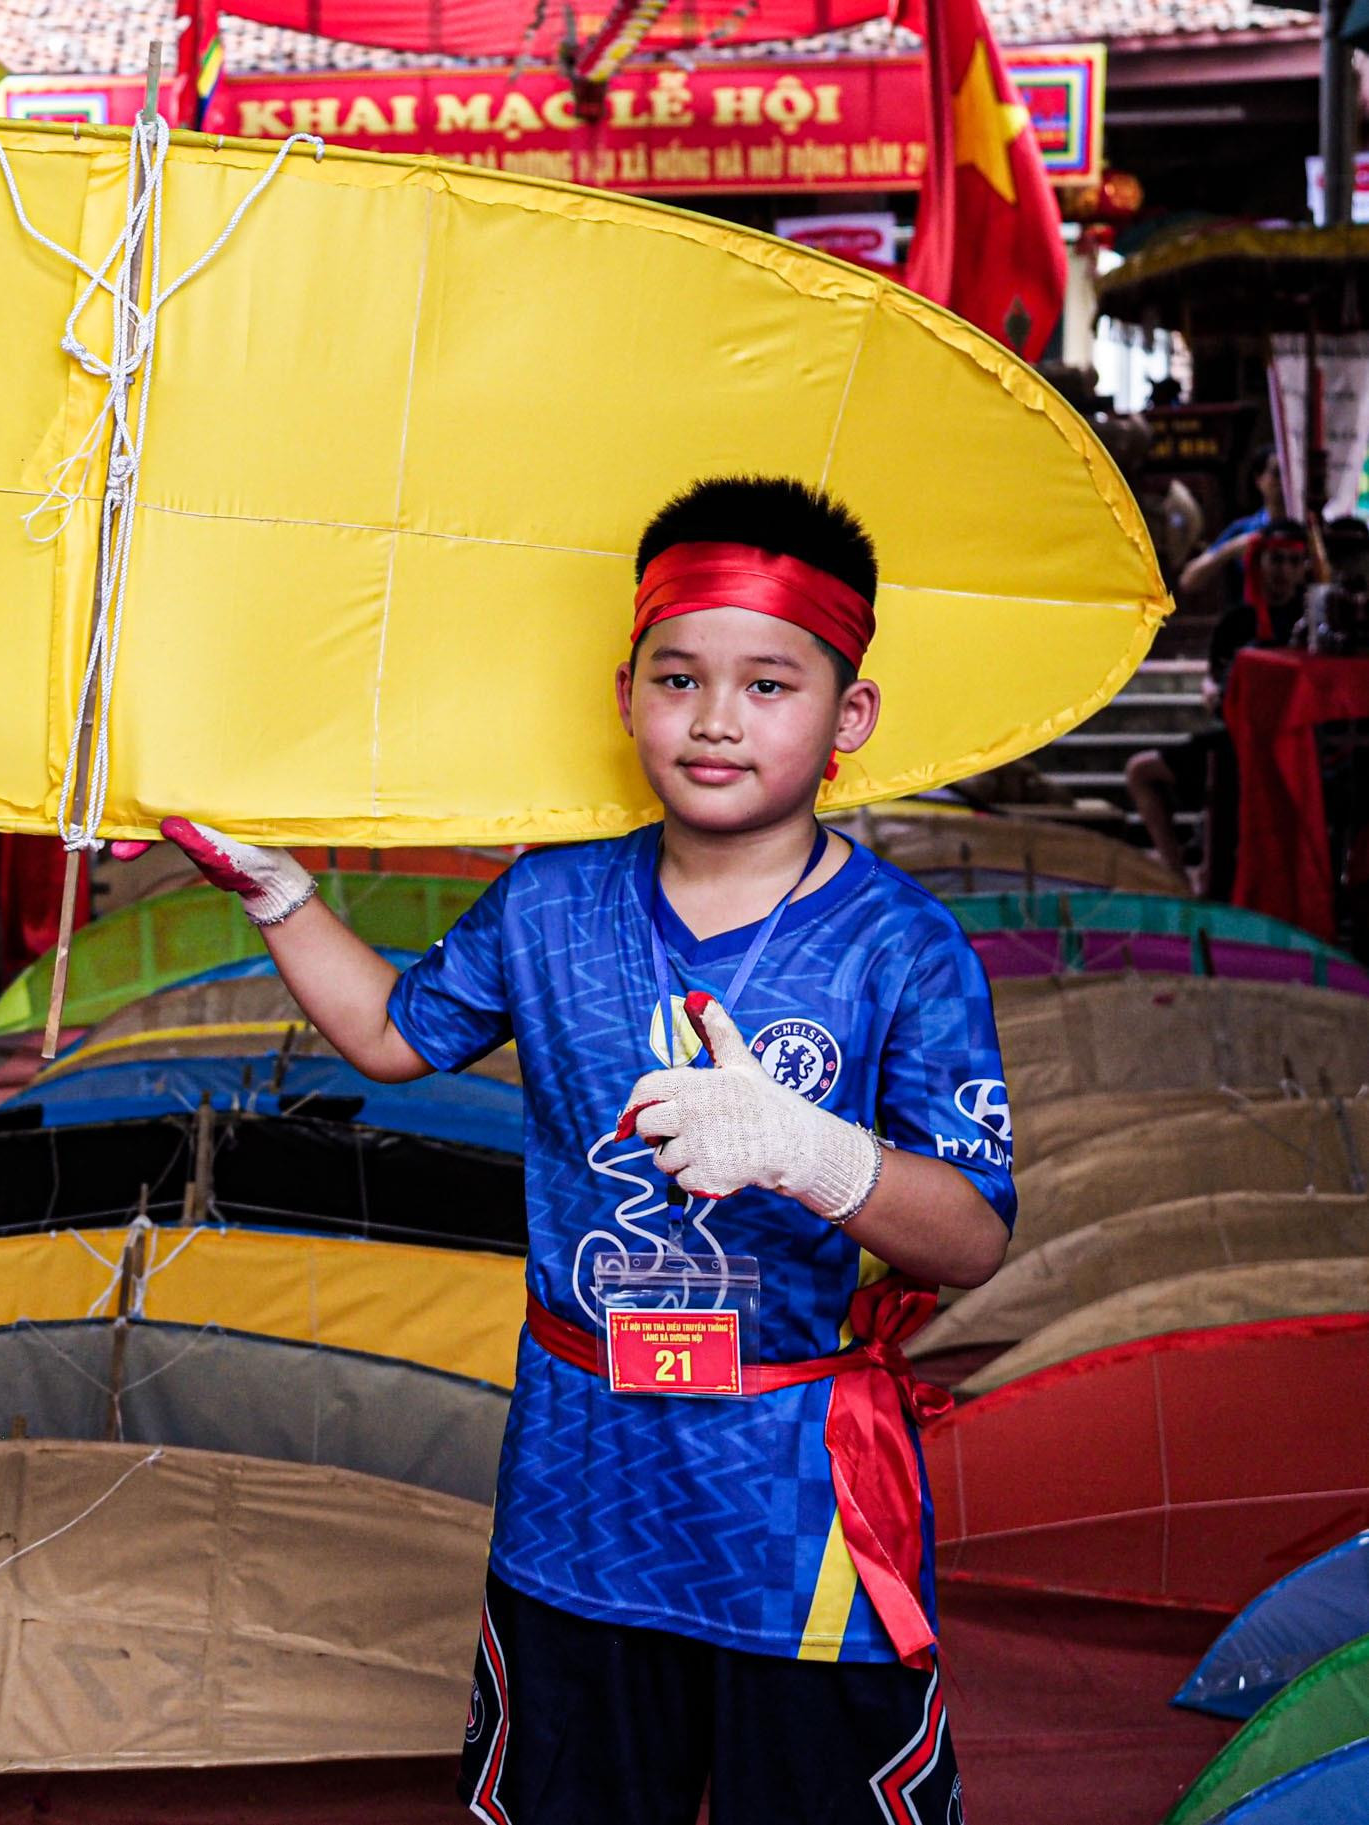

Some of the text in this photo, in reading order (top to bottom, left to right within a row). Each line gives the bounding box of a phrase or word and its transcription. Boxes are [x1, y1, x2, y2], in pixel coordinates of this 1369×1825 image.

[239, 71, 841, 140] KHAI MẠC LỄ HỘI
[772, 1024, 830, 1052] CHELSEA
[655, 1349, 692, 1382] 21
